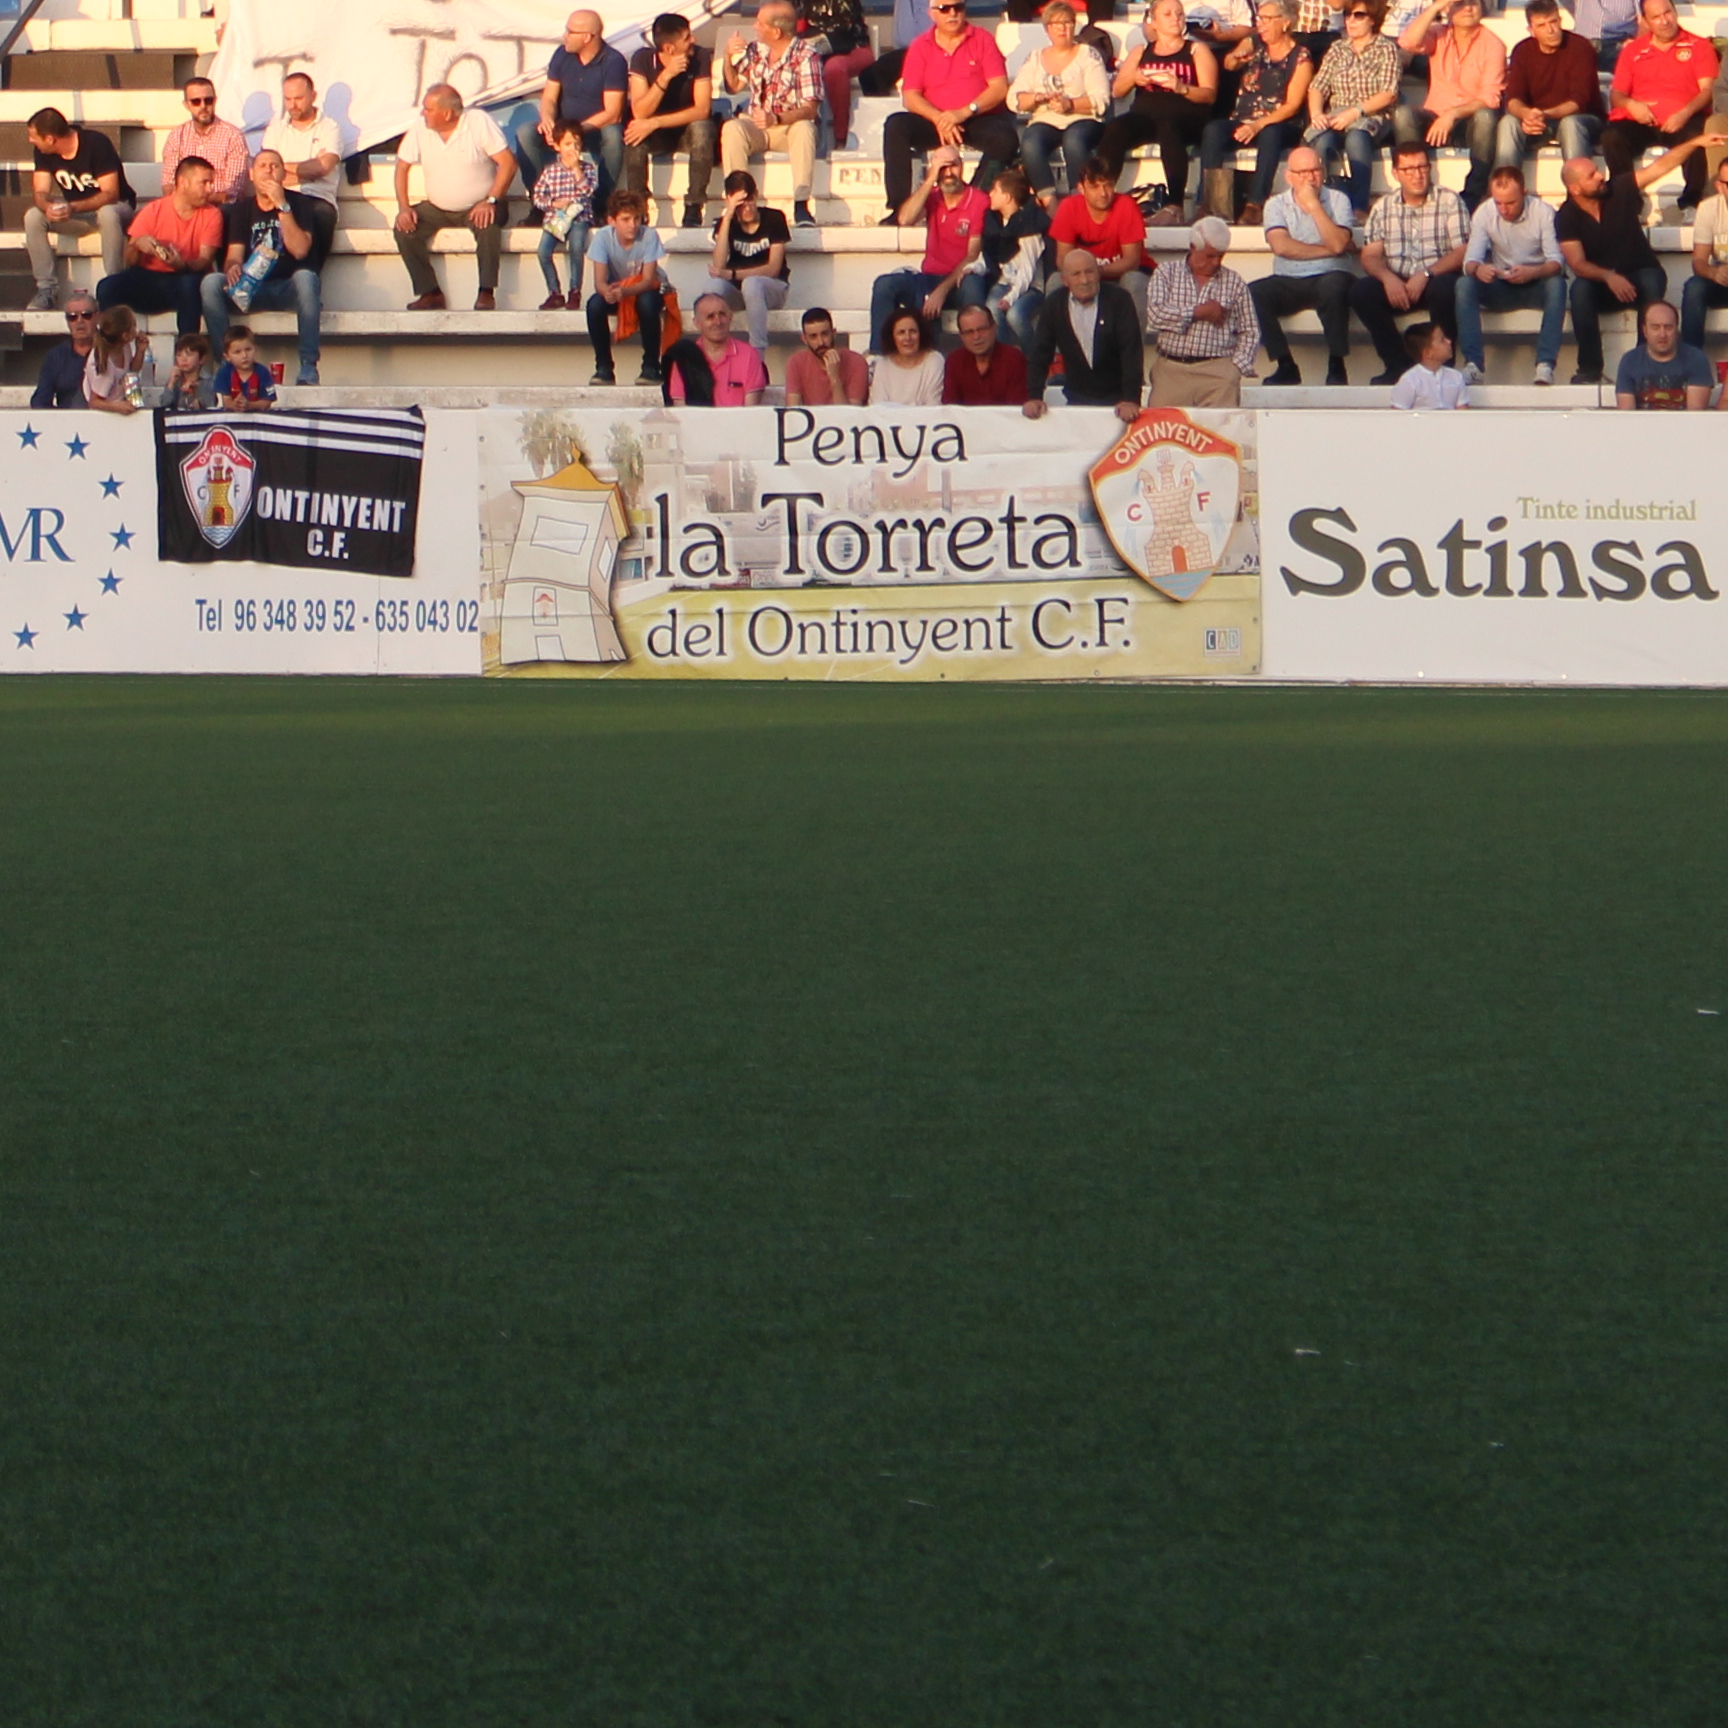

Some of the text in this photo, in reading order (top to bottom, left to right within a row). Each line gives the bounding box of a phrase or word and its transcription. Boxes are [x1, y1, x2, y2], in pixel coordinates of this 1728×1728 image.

[773, 406, 968, 478] Penya
[1114, 421, 1215, 465] ONTINYENT
[196, 484, 241, 500] C F
[256, 484, 406, 534] ONTINYENT
[1127, 491, 1211, 522] C F
[1516, 496, 1697, 522] Tinte industrial
[306, 529, 351, 561] C.F.
[654, 492, 1081, 579] la Torreta
[1279, 506, 1721, 603] Satinsa
[195, 597, 223, 633] Tel
[234, 598, 257, 633] 96
[263, 598, 298, 633] 348
[304, 598, 328, 633] 39
[333, 598, 356, 633] 52
[375, 598, 410, 633] 635
[415, 598, 451, 633] 043
[455, 598, 479, 633] 02
[647, 597, 1132, 665] del Ontinyent C.F.
